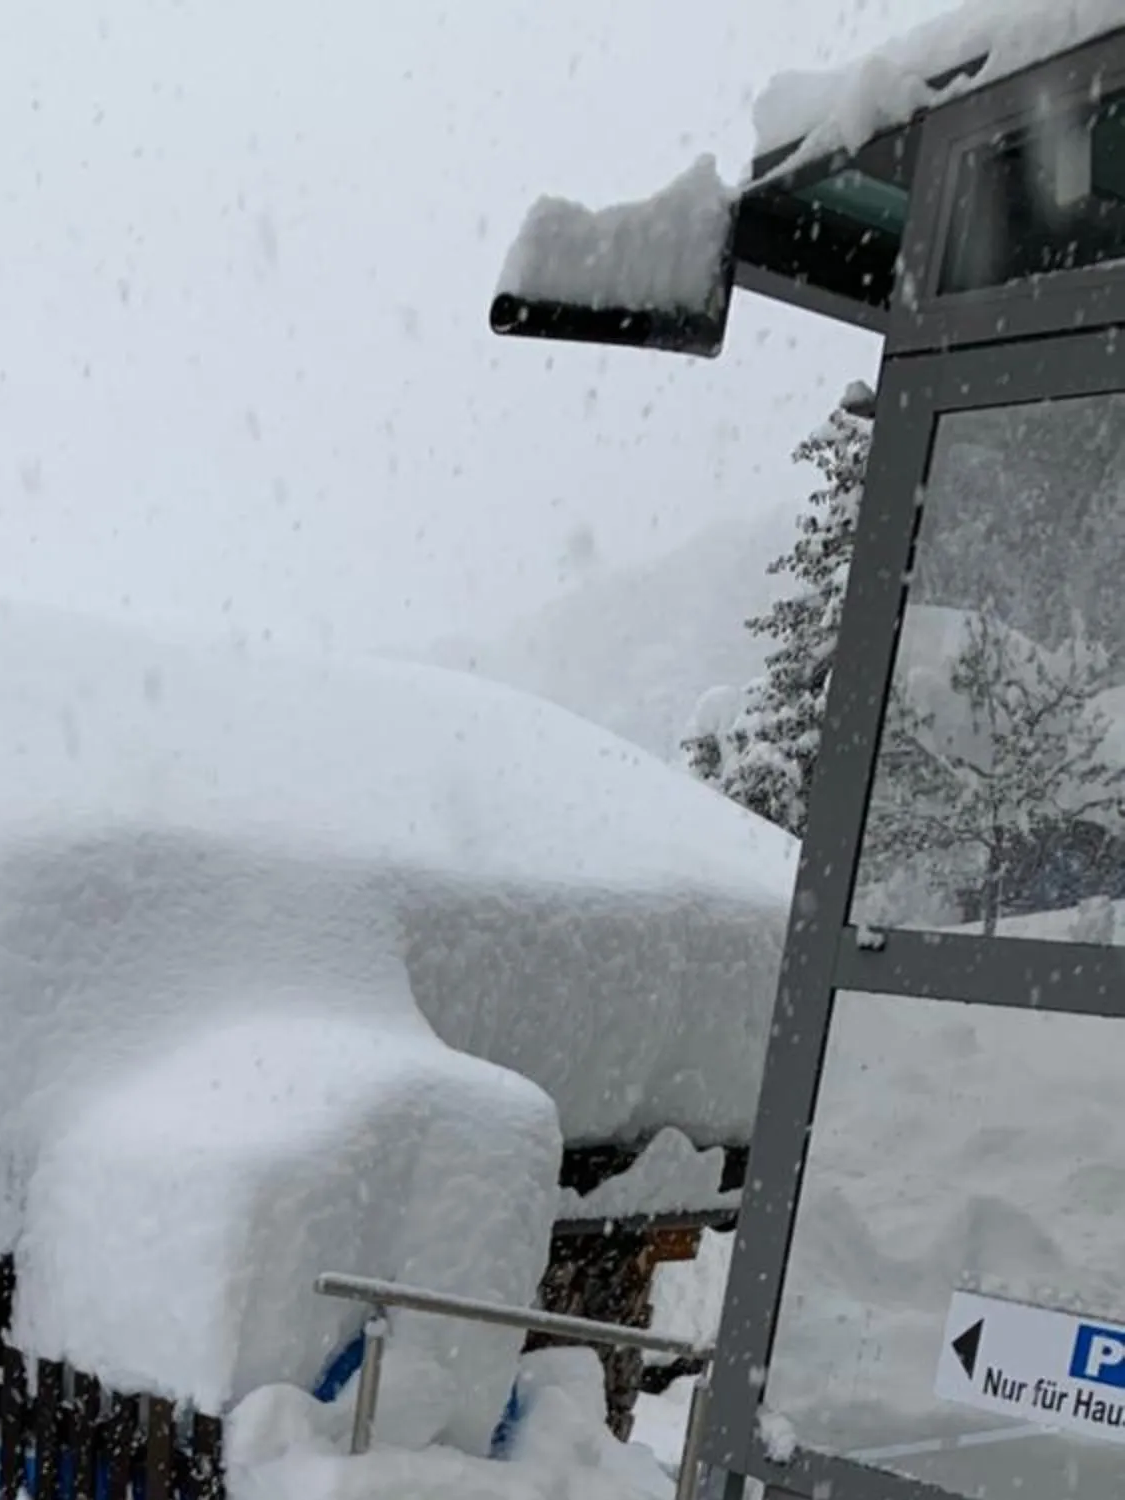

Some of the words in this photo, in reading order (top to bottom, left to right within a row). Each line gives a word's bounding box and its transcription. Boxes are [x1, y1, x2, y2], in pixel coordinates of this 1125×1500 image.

[1085, 1335, 1124, 1378] P
[983, 1367, 1027, 1403] Nur
[1032, 1378, 1068, 1413] für
[1073, 1388, 1125, 1428] Hau
